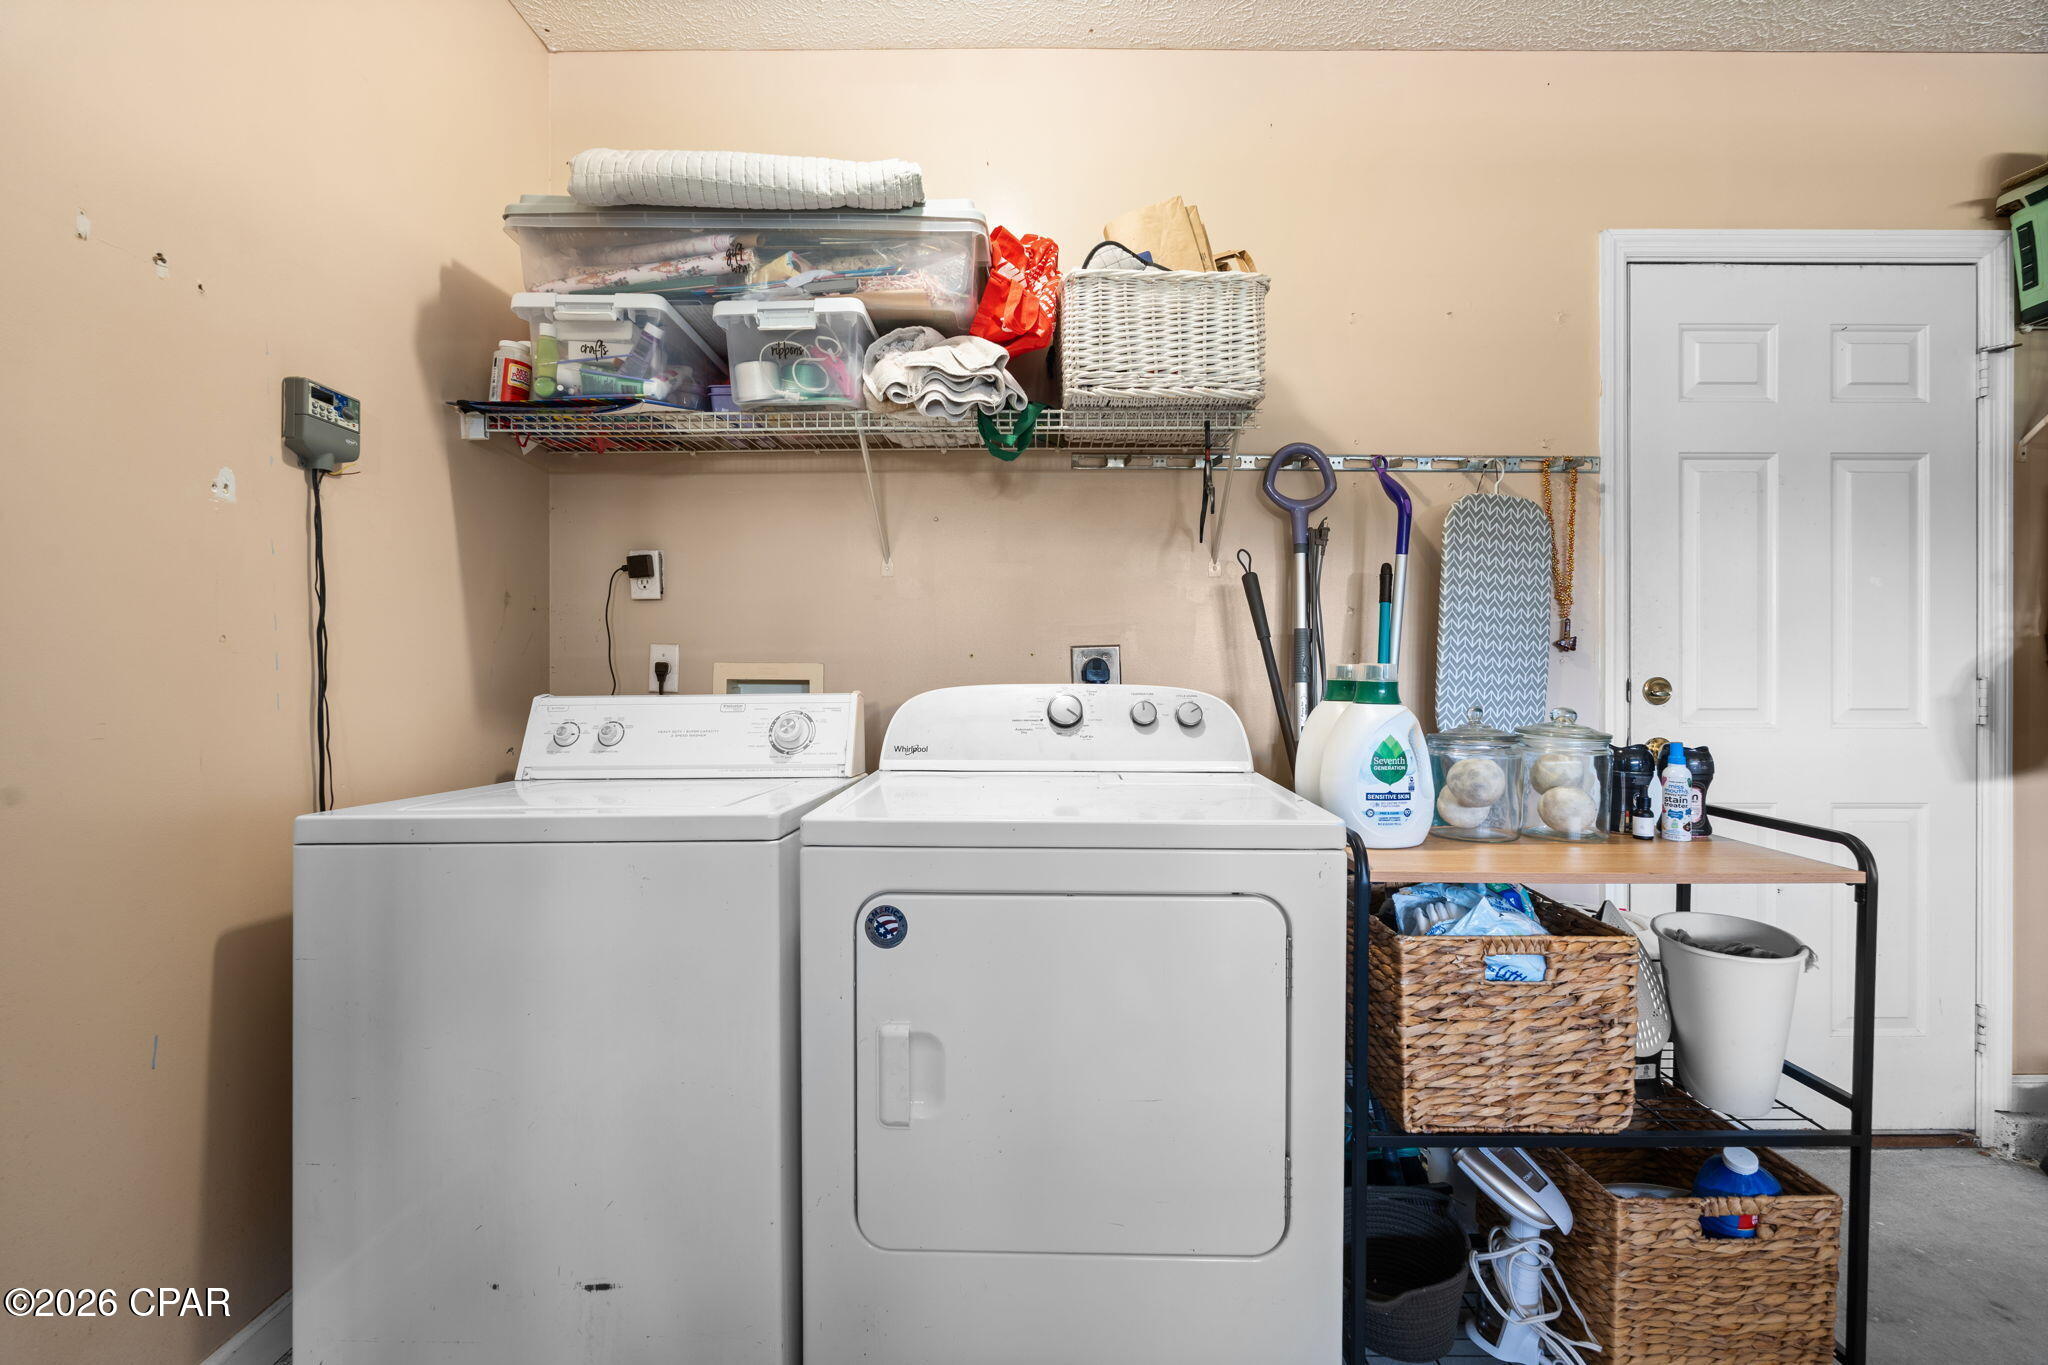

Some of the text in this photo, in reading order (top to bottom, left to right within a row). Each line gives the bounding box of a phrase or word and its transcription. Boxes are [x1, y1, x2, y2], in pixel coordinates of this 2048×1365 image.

[726, 243, 744, 266] gift
[580, 339, 608, 361] crafts
[771, 341, 804, 359] ribbons
[894, 744, 928, 756] Whirlpool
[1374, 756, 1405, 765] Seventh
